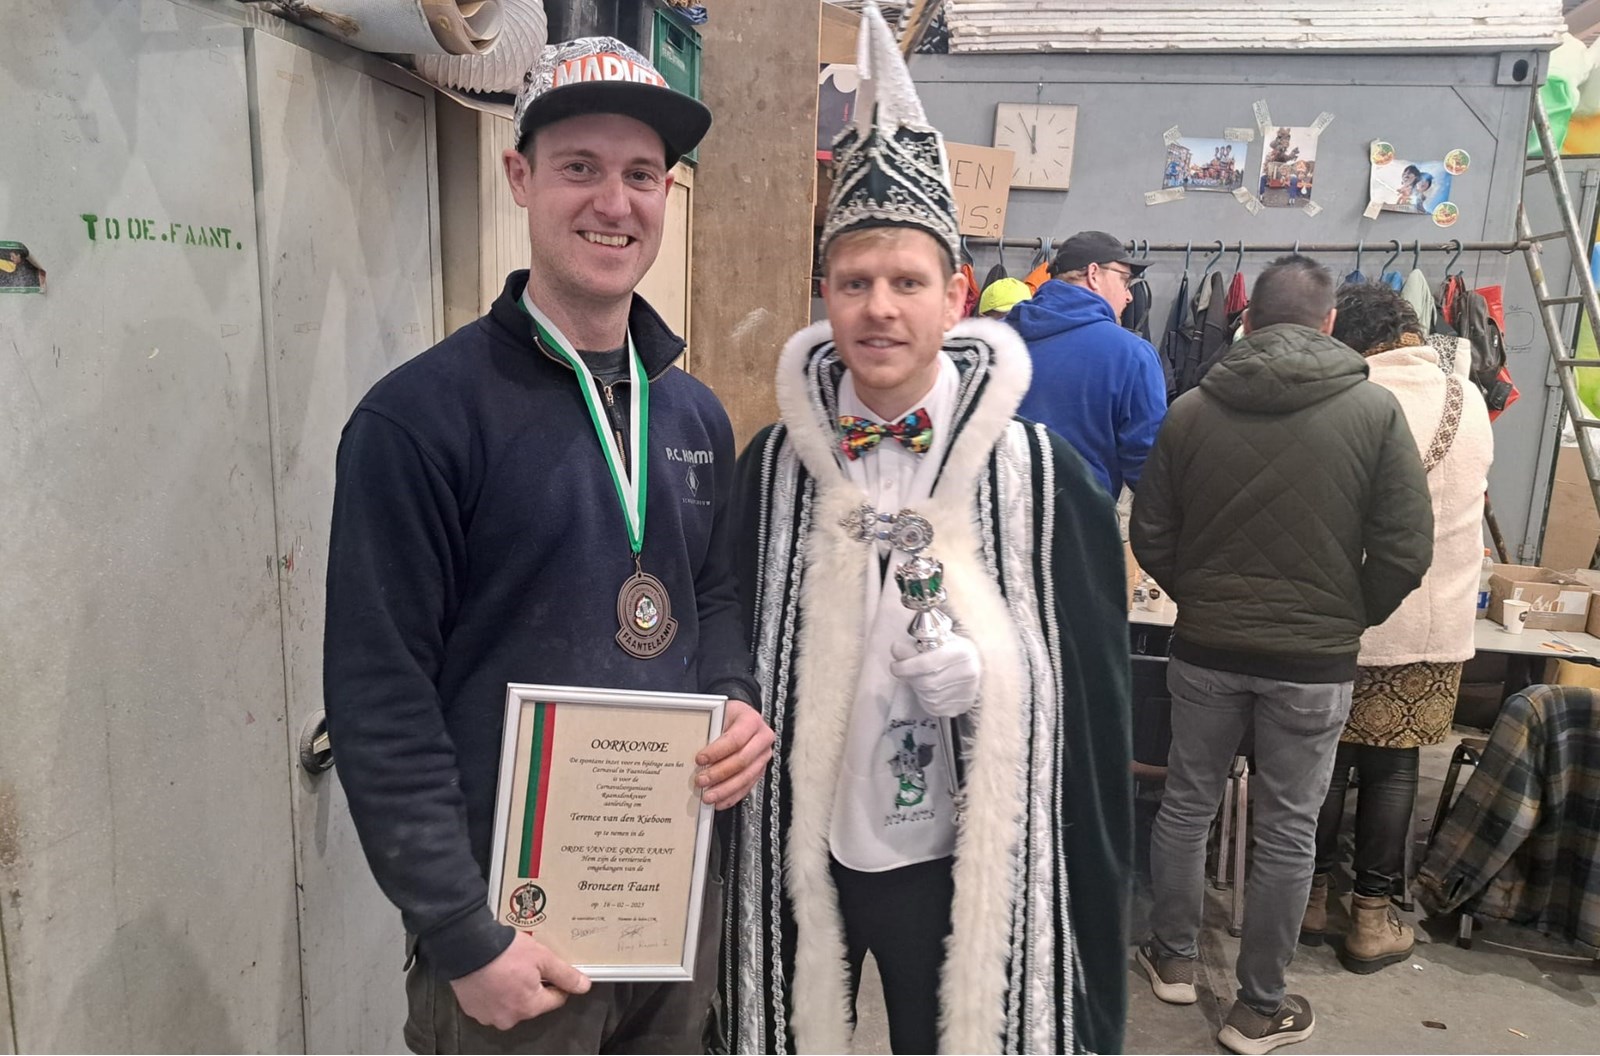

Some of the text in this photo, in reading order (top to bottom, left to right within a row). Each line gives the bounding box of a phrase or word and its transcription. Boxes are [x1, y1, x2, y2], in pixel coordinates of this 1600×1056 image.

[948, 159, 995, 190] EN
[622, 623, 673, 652] FAANTELAAND
[591, 738, 669, 753] OORKONDE
[570, 812, 601, 821] Terence
[620, 813, 635, 822] den
[637, 814, 672, 824] Kieboom
[560, 845, 584, 853] ORDE
[586, 845, 605, 853] VAN
[619, 847, 645, 855] GROTE
[647, 847, 676, 855] FAANT
[578, 880, 660, 892] Bronzen Faant
